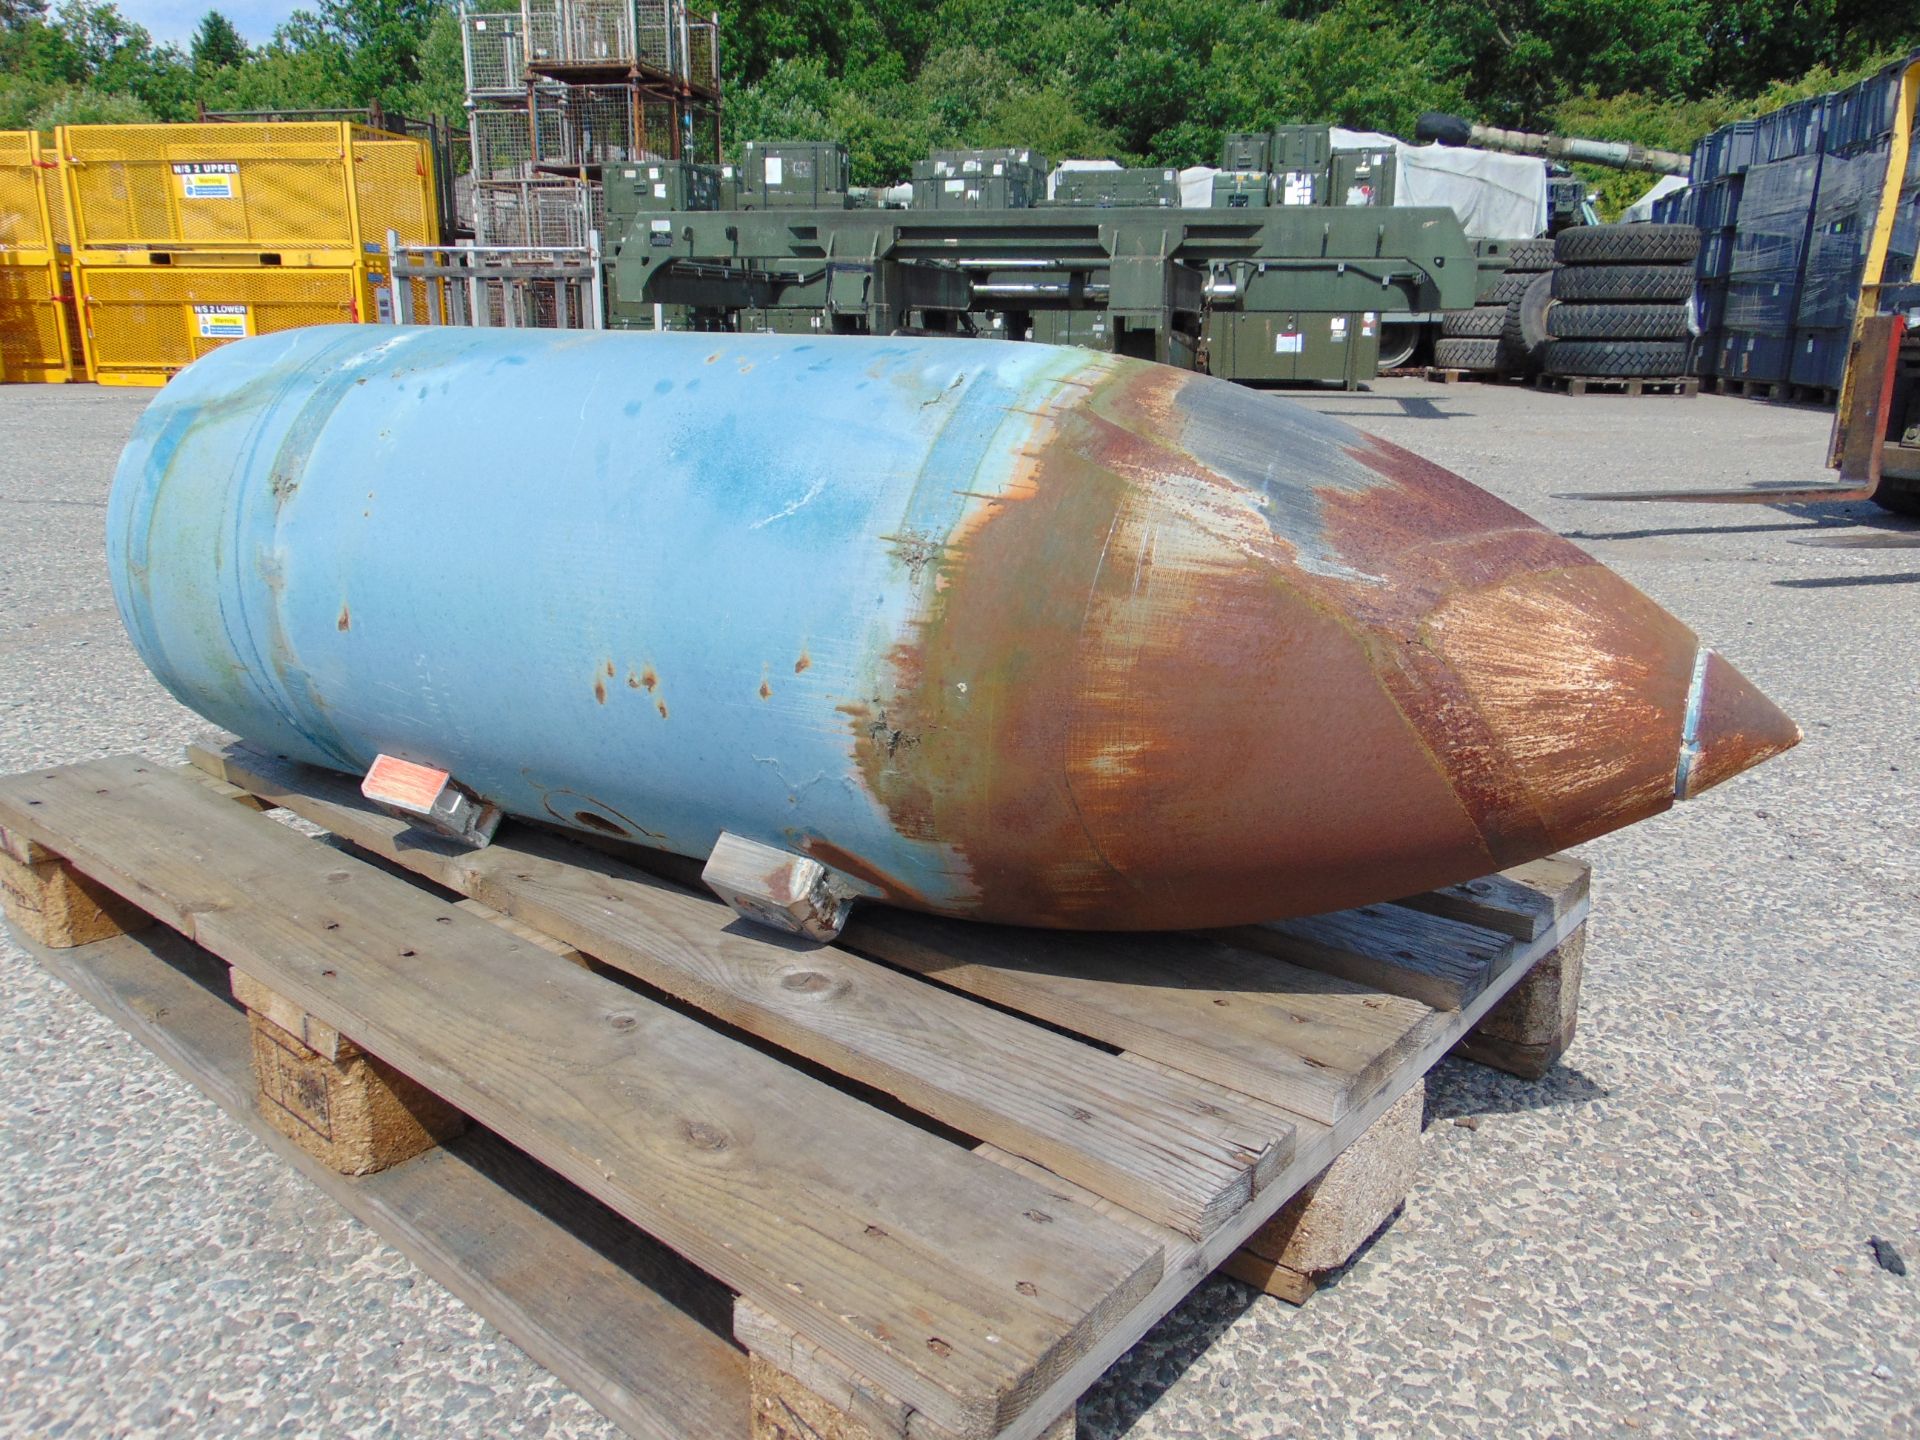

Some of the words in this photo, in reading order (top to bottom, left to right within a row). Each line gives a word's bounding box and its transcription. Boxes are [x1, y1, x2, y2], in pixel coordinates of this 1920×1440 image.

[173, 164, 191, 173] N/S
[193, 164, 201, 173] 2
[203, 164, 238, 173] UPPER
[216, 305, 246, 313] LOWER
